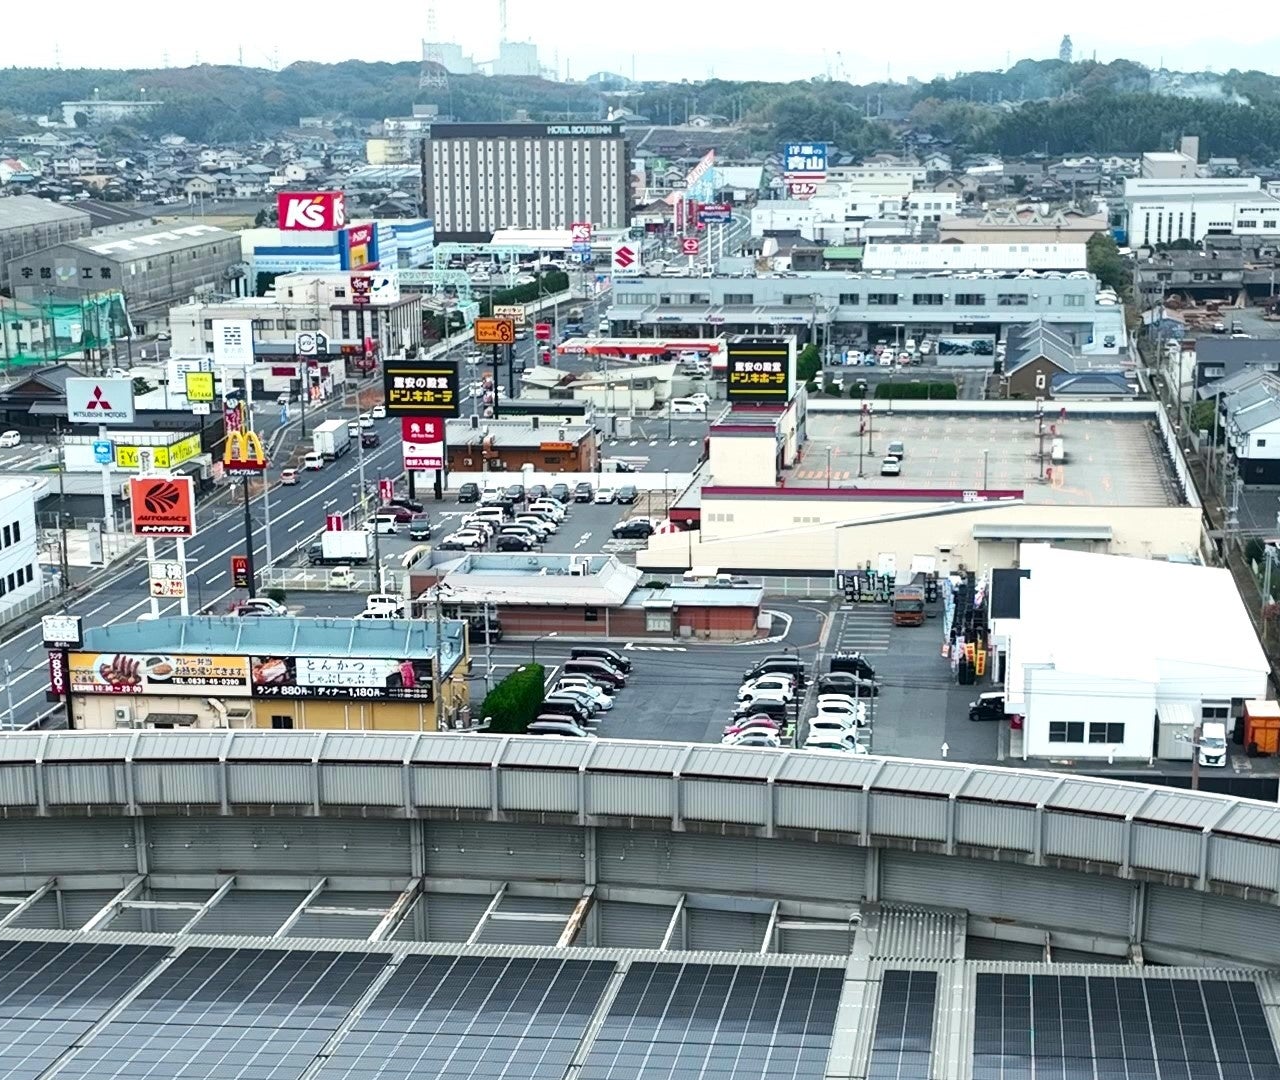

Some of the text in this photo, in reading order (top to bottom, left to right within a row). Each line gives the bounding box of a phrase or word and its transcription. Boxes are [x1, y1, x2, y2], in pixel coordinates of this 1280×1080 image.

[547, 126, 570, 135] HOTEL
[571, 126, 595, 135] ROUTE
[787, 156, 824, 170] 青山
[791, 183, 817, 194] セルフ
[393, 377, 448, 389] 驚安の殿堂
[176, 658, 212, 666] カレー弁当
[306, 659, 365, 671] とんかつ
[308, 673, 366, 685] しゃぶしゃぶ
[257, 686, 279, 695] ランチ
[318, 686, 347, 695] ディナー
